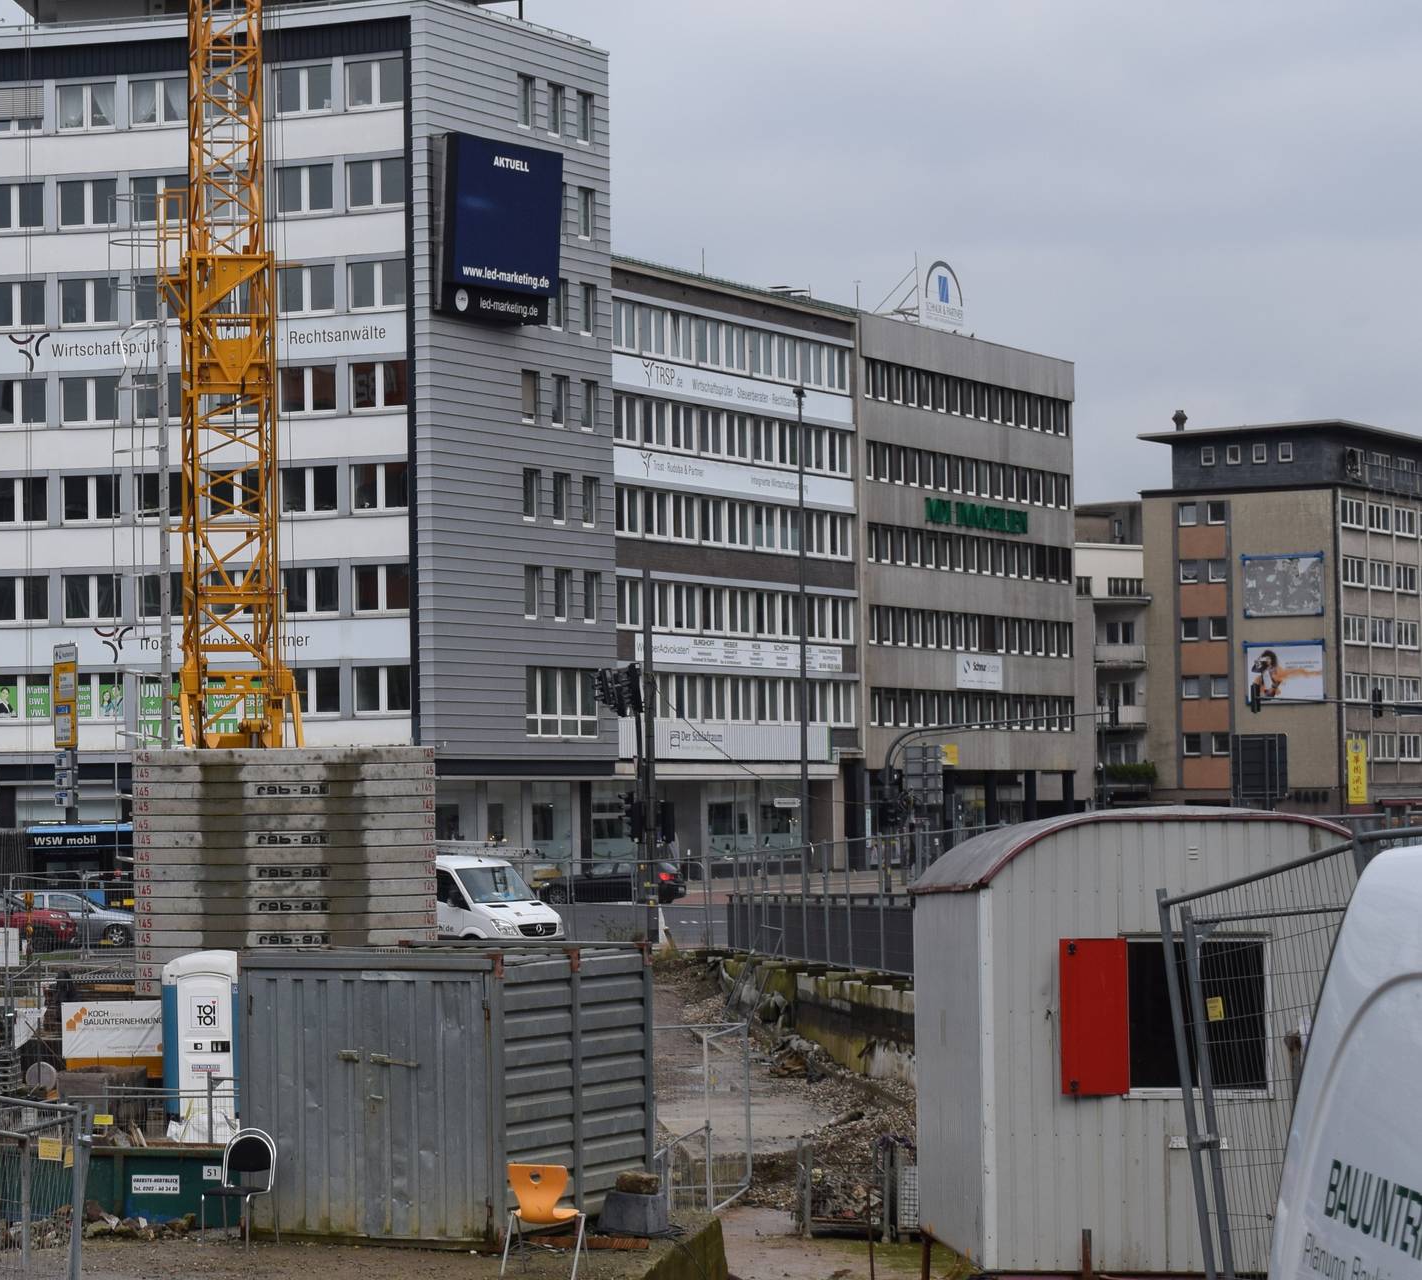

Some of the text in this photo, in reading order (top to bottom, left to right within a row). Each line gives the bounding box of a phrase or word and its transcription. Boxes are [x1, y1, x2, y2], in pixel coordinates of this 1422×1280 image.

[493, 155, 530, 172] AKTUELL
[462, 265, 550, 290] www.led-marketing.de
[479, 297, 538, 318] led-marketing.de
[50, 326, 387, 360] Wirtschaftsprüf Rechtsanwälte
[136, 769, 149, 778] 145
[135, 787, 149, 796] 145
[135, 802, 149, 812] 145
[135, 819, 149, 829] 145
[34, 835, 97, 846] WSW mobil
[136, 835, 151, 845] 145
[136, 852, 150, 862] 145
[136, 869, 150, 879] 145
[137, 885, 152, 895] 145
[136, 902, 152, 912] 145
[138, 919, 152, 928] 145
[137, 934, 151, 943] 145
[137, 951, 152, 961] 145
[138, 968, 153, 978] 145
[137, 982, 152, 992] 145
[196, 1015, 216, 1026] TOI
[206, 1168, 217, 1177] 51
